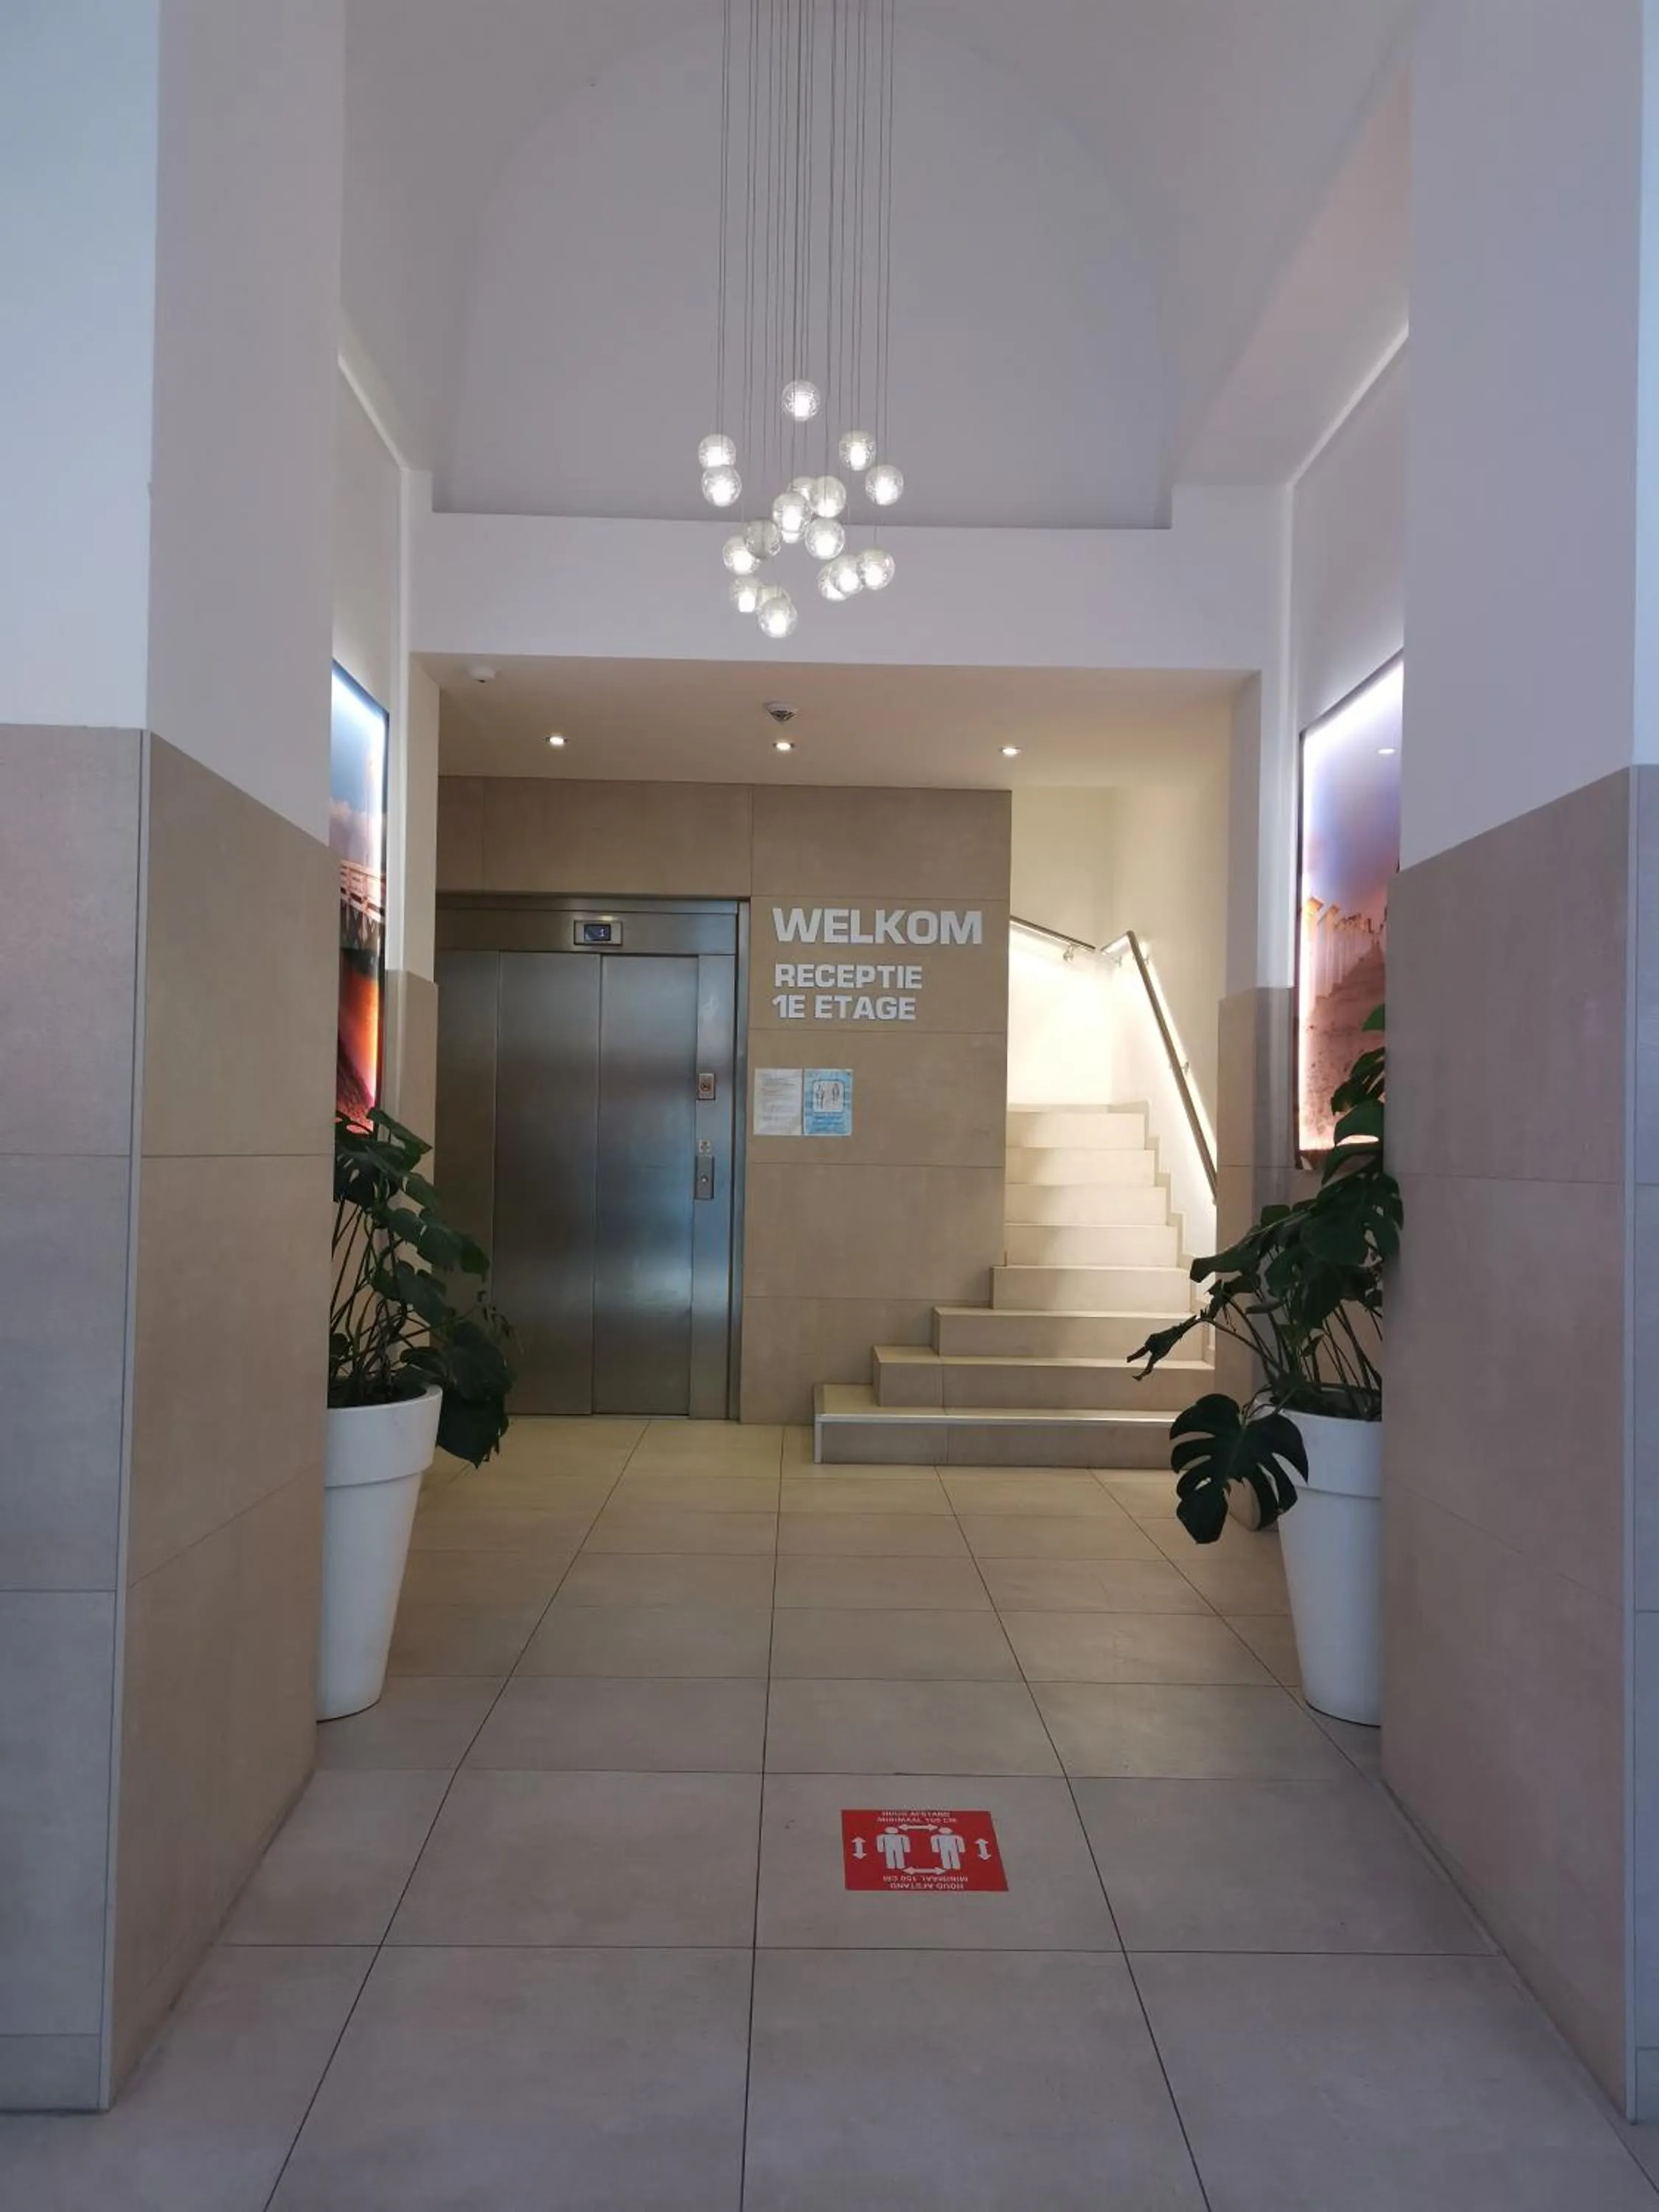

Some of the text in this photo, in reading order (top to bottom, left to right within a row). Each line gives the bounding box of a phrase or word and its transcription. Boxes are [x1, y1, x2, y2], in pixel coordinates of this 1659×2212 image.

[773, 908, 982, 945] WELKOM
[775, 963, 923, 989] RECEPTIE
[772, 995, 917, 1020] 1E ETAGE
